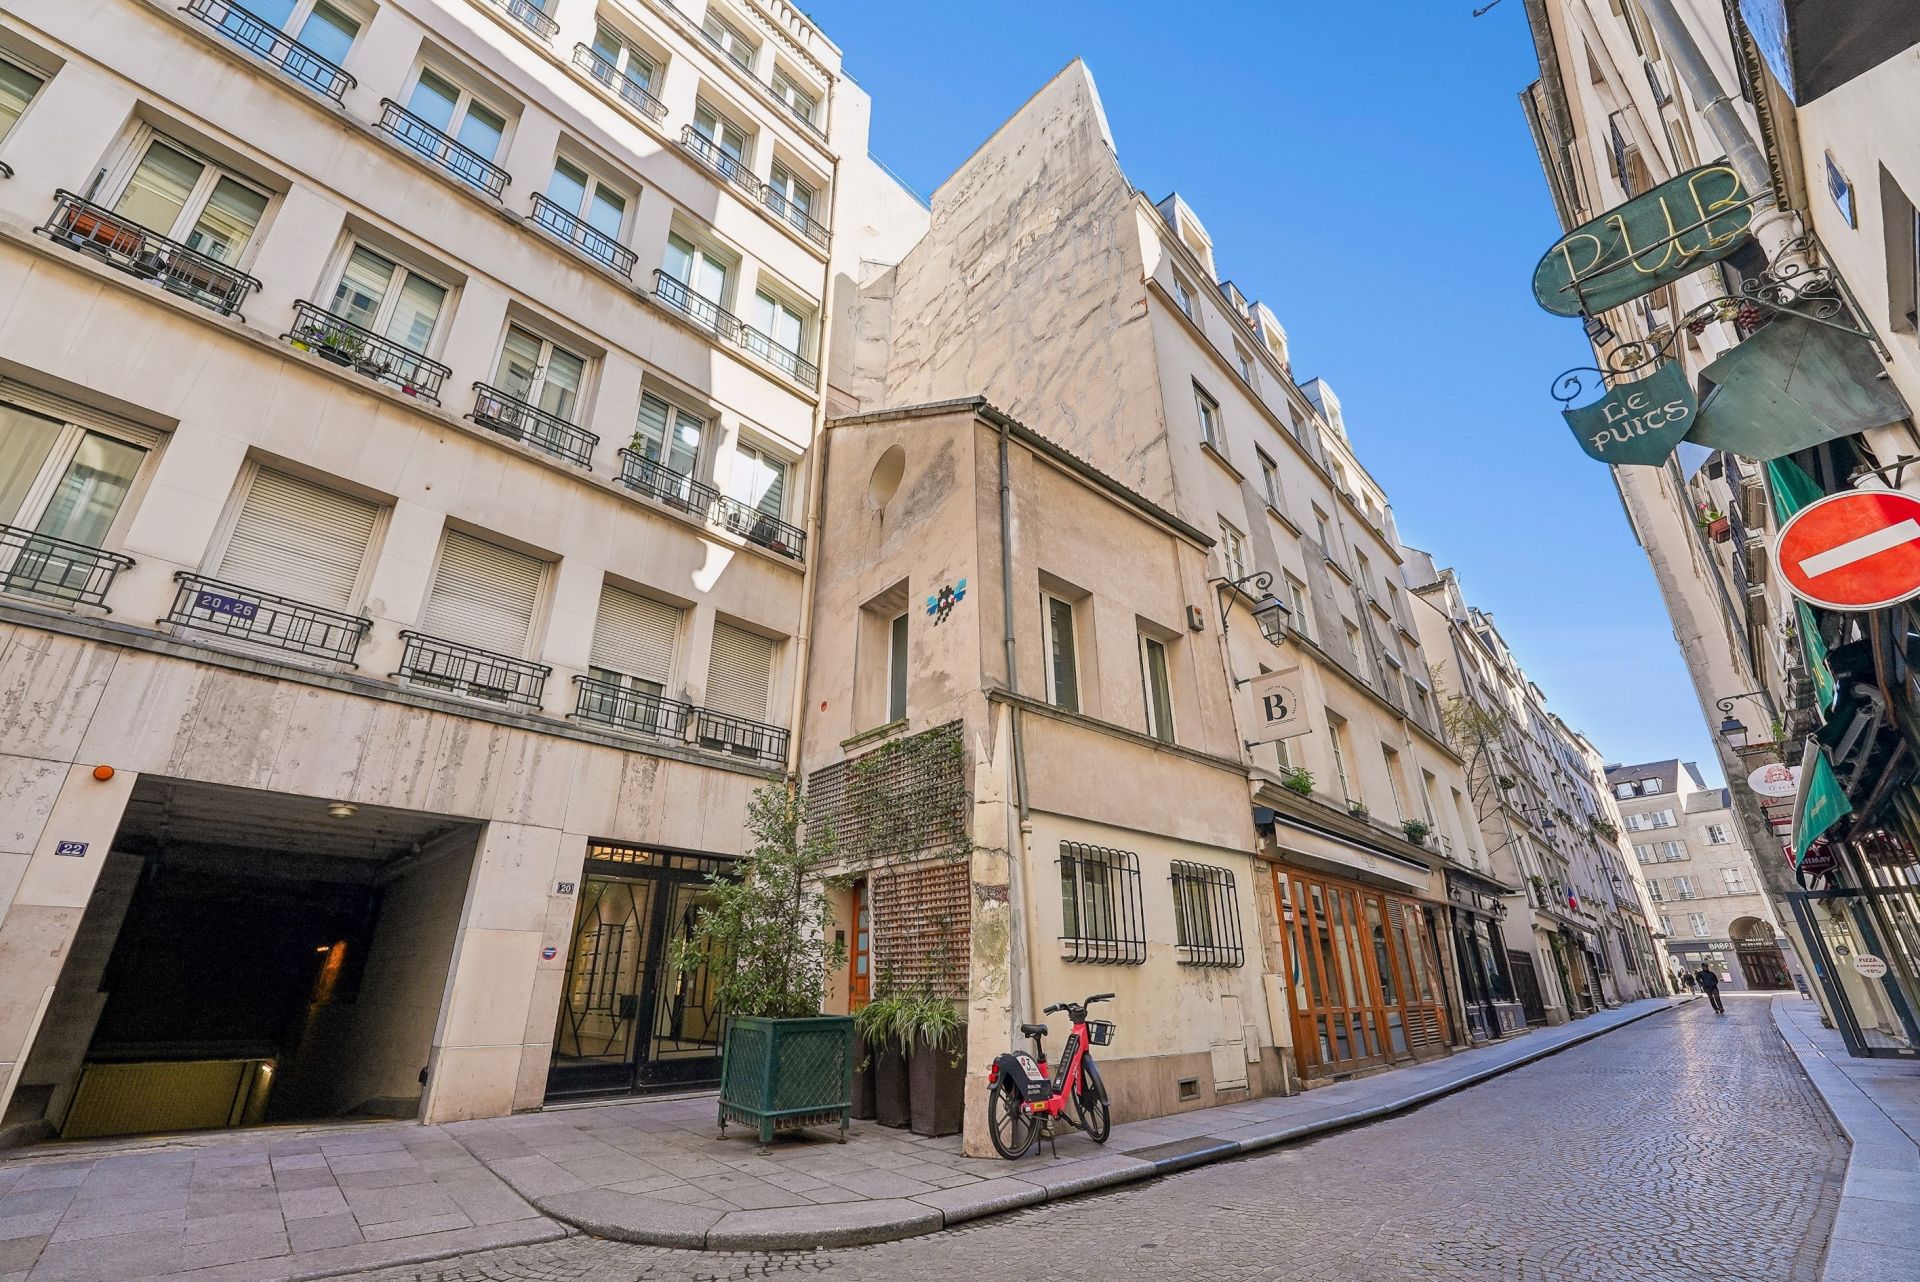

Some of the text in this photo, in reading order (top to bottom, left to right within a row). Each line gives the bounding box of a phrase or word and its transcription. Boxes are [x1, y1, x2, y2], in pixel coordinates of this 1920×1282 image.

[1552, 166, 1754, 283] PUB
[1602, 391, 1650, 424] LE
[1589, 398, 1689, 452] PUITS
[201, 595, 222, 608] 20
[233, 603, 253, 616] 26
[1262, 693, 1288, 722] B
[61, 843, 82, 855] 22
[1799, 855, 1832, 866] HIMAY
[560, 884, 572, 893] 20
